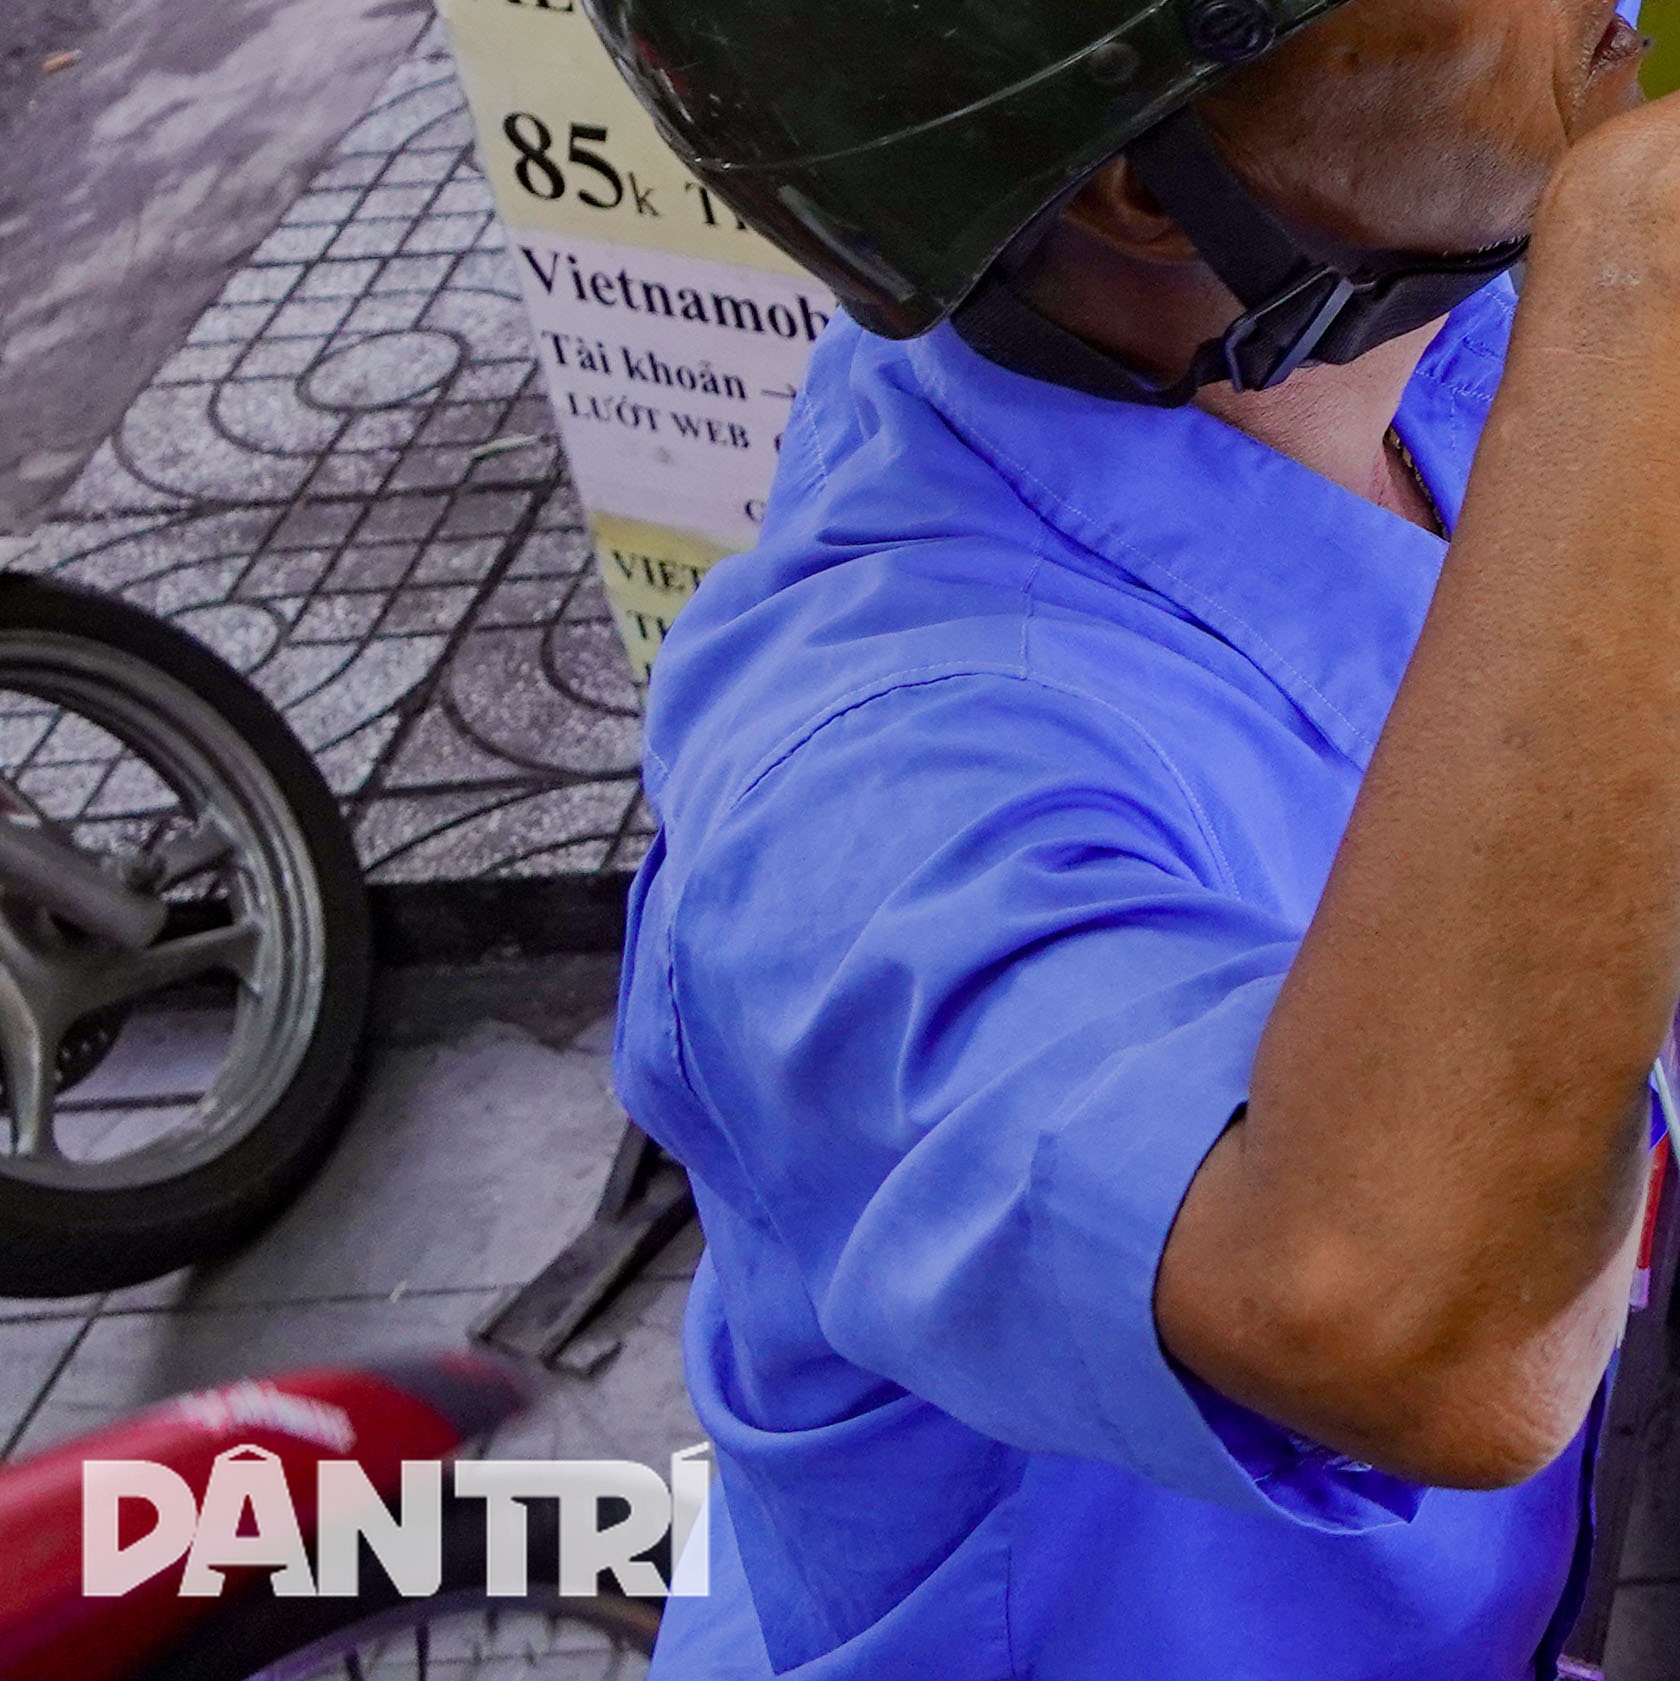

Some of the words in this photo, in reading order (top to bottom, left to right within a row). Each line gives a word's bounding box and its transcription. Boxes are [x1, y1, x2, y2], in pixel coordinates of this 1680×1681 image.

[519, 245, 828, 343] Vietnamob
[542, 330, 611, 375] Tài
[622, 346, 747, 400] khoản
[672, 412, 751, 449] WEB
